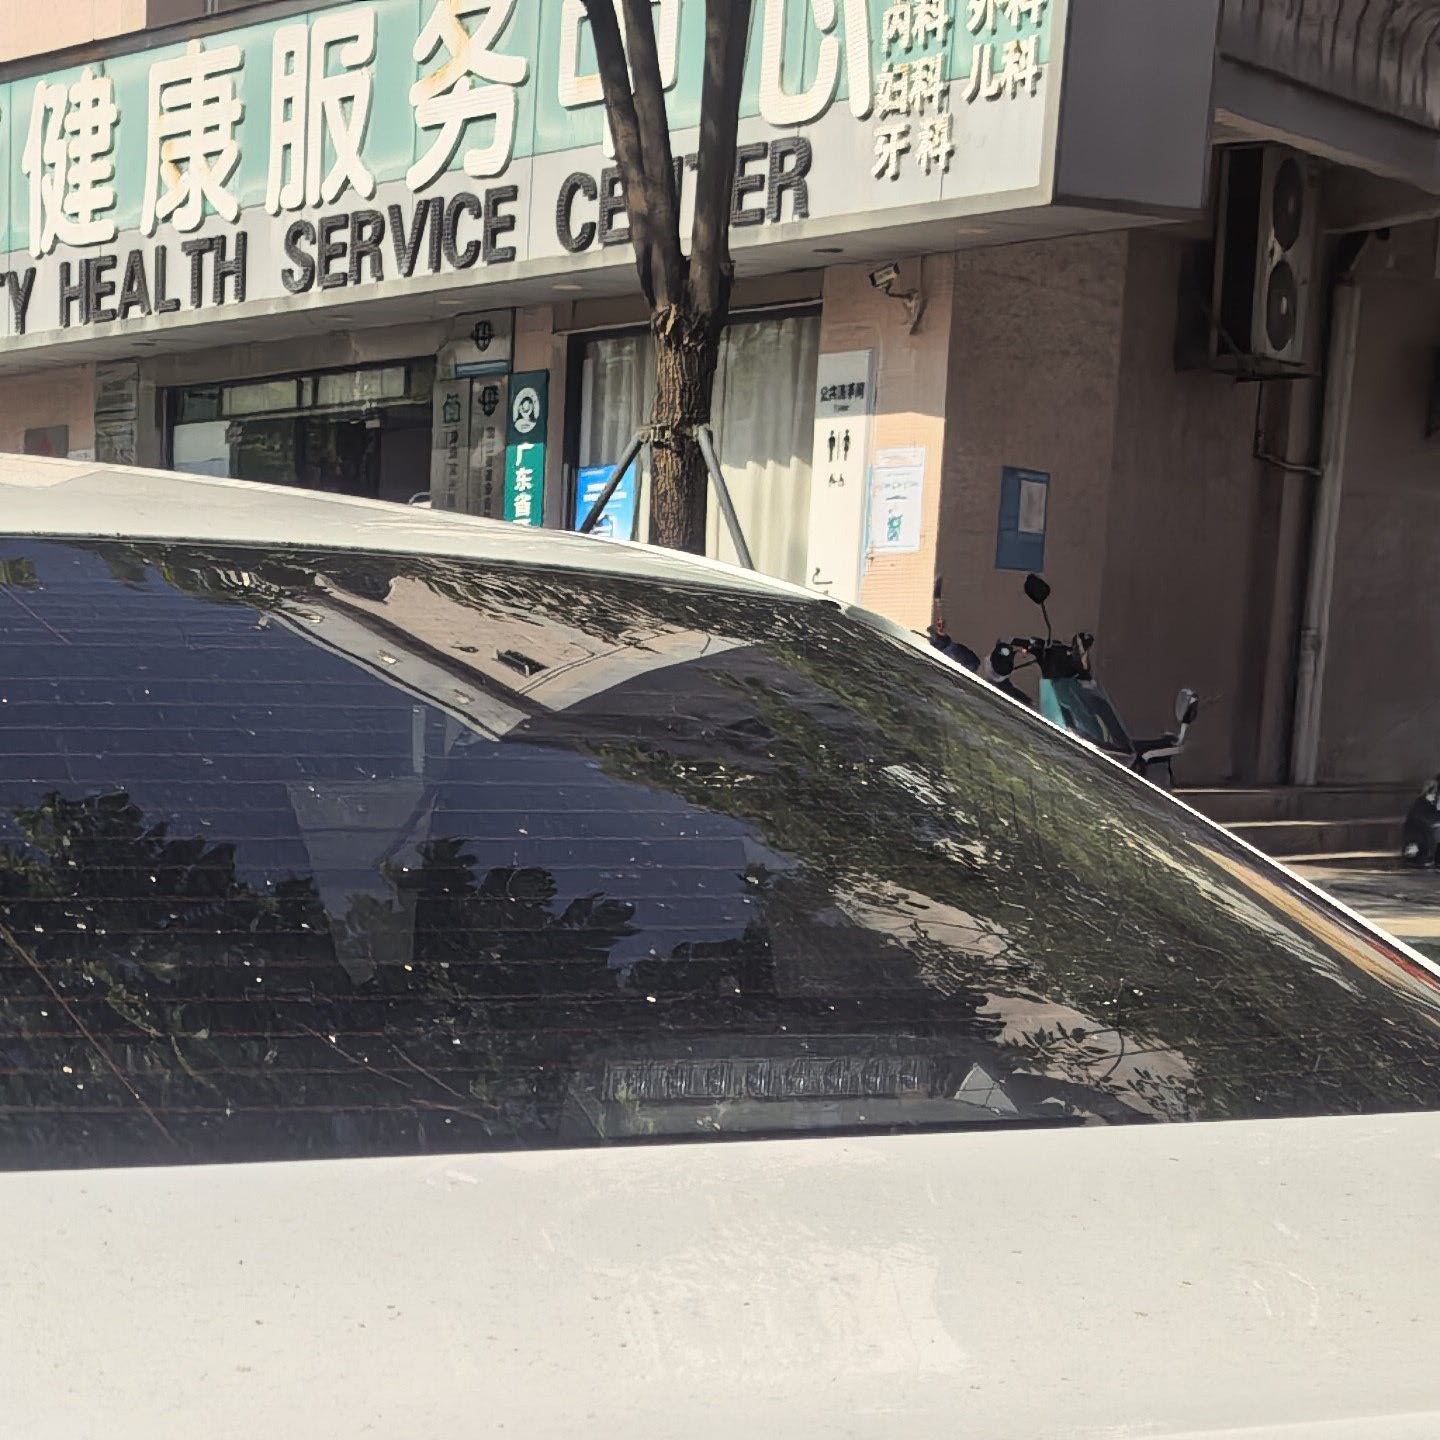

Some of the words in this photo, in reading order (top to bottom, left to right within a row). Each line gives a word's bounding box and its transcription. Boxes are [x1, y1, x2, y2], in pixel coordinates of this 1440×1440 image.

[874, 53, 946, 116] 妇科
[960, 34, 1039, 102] 儿科
[871, 113, 953, 178] 牙科
[60, 230, 246, 328] HEALTH
[281, 184, 519, 294] SERVICE
